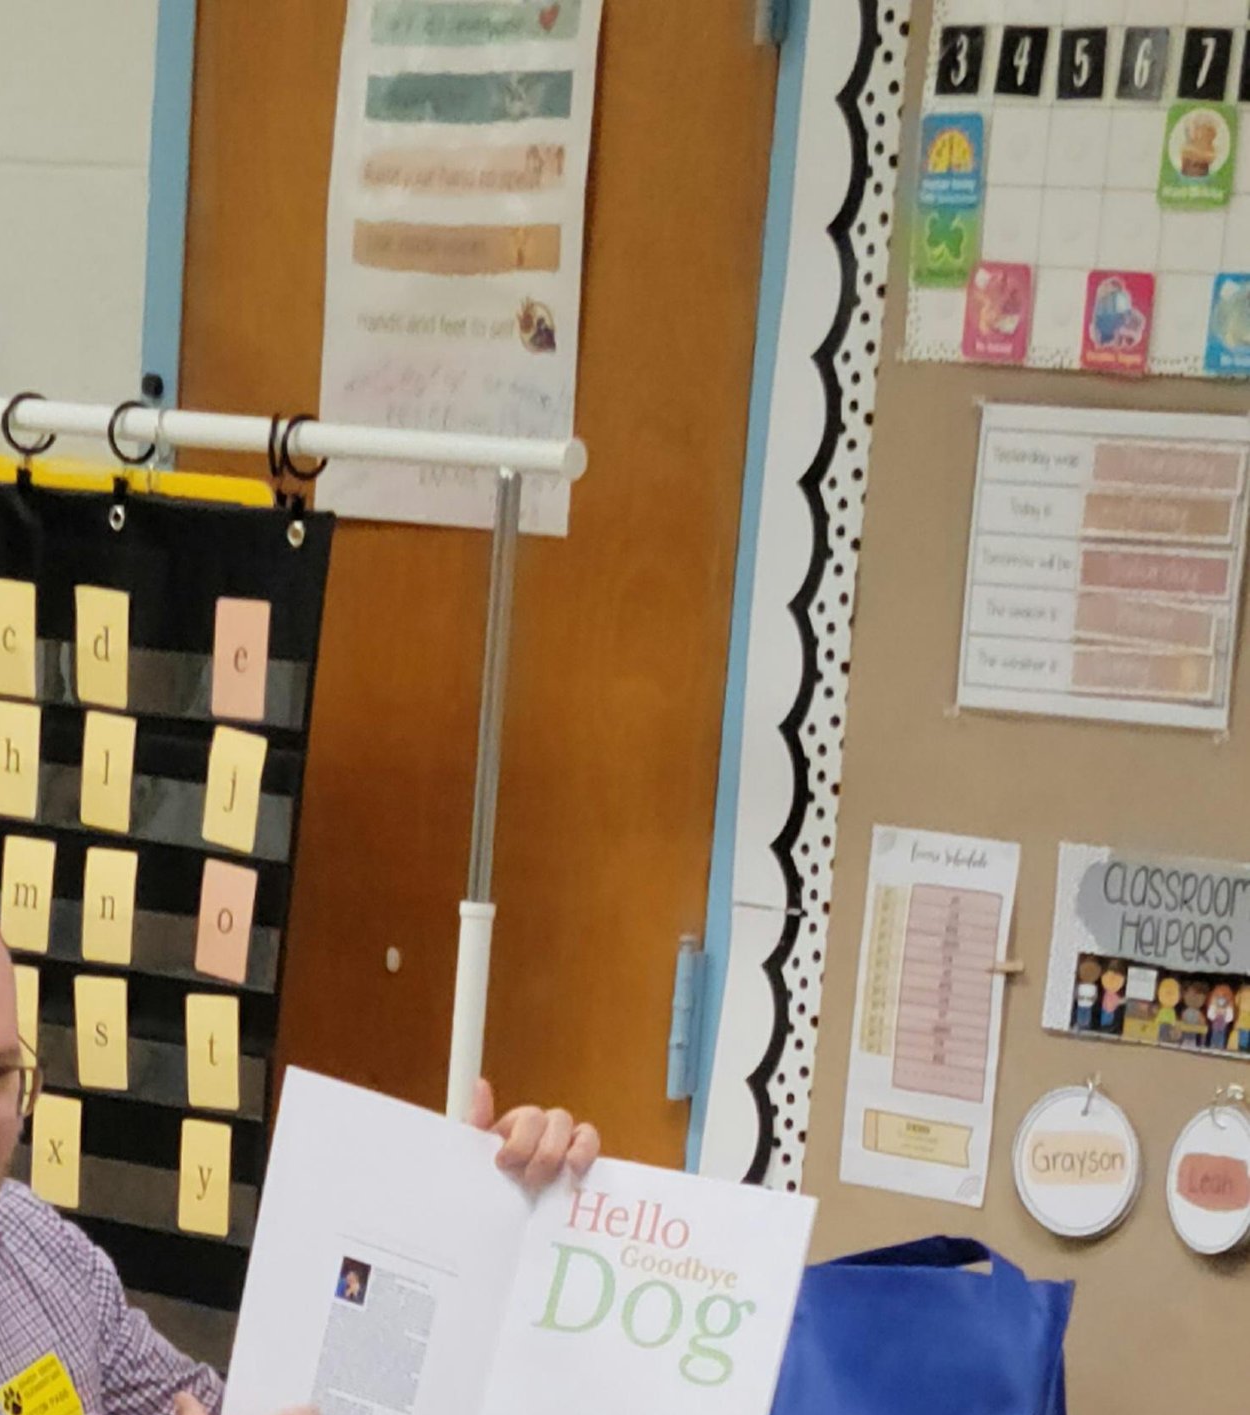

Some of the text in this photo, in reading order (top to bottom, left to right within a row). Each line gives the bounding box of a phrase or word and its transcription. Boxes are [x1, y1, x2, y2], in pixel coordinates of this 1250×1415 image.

[950, 33, 970, 87] 3
[1013, 36, 1033, 87] 4
[1072, 38, 1091, 88] 5
[1133, 38, 1152, 89] 6
[1196, 37, 1217, 89] 7
[1, 625, 17, 654] c
[92, 626, 111, 662] d
[3, 739, 23, 775] h
[222, 769, 239, 812] j
[12, 879, 40, 911] m
[99, 893, 117, 922] n
[216, 907, 235, 936] o
[93, 1022, 110, 1050] s
[205, 1037, 221, 1068] t
[46, 1138, 65, 1167] x
[1031, 1141, 1126, 1175] Grayson
[196, 1164, 215, 1200] y
[563, 1187, 691, 1251] Hello
[618, 1245, 739, 1291] Goodbye
[532, 1241, 757, 1388] Dog
